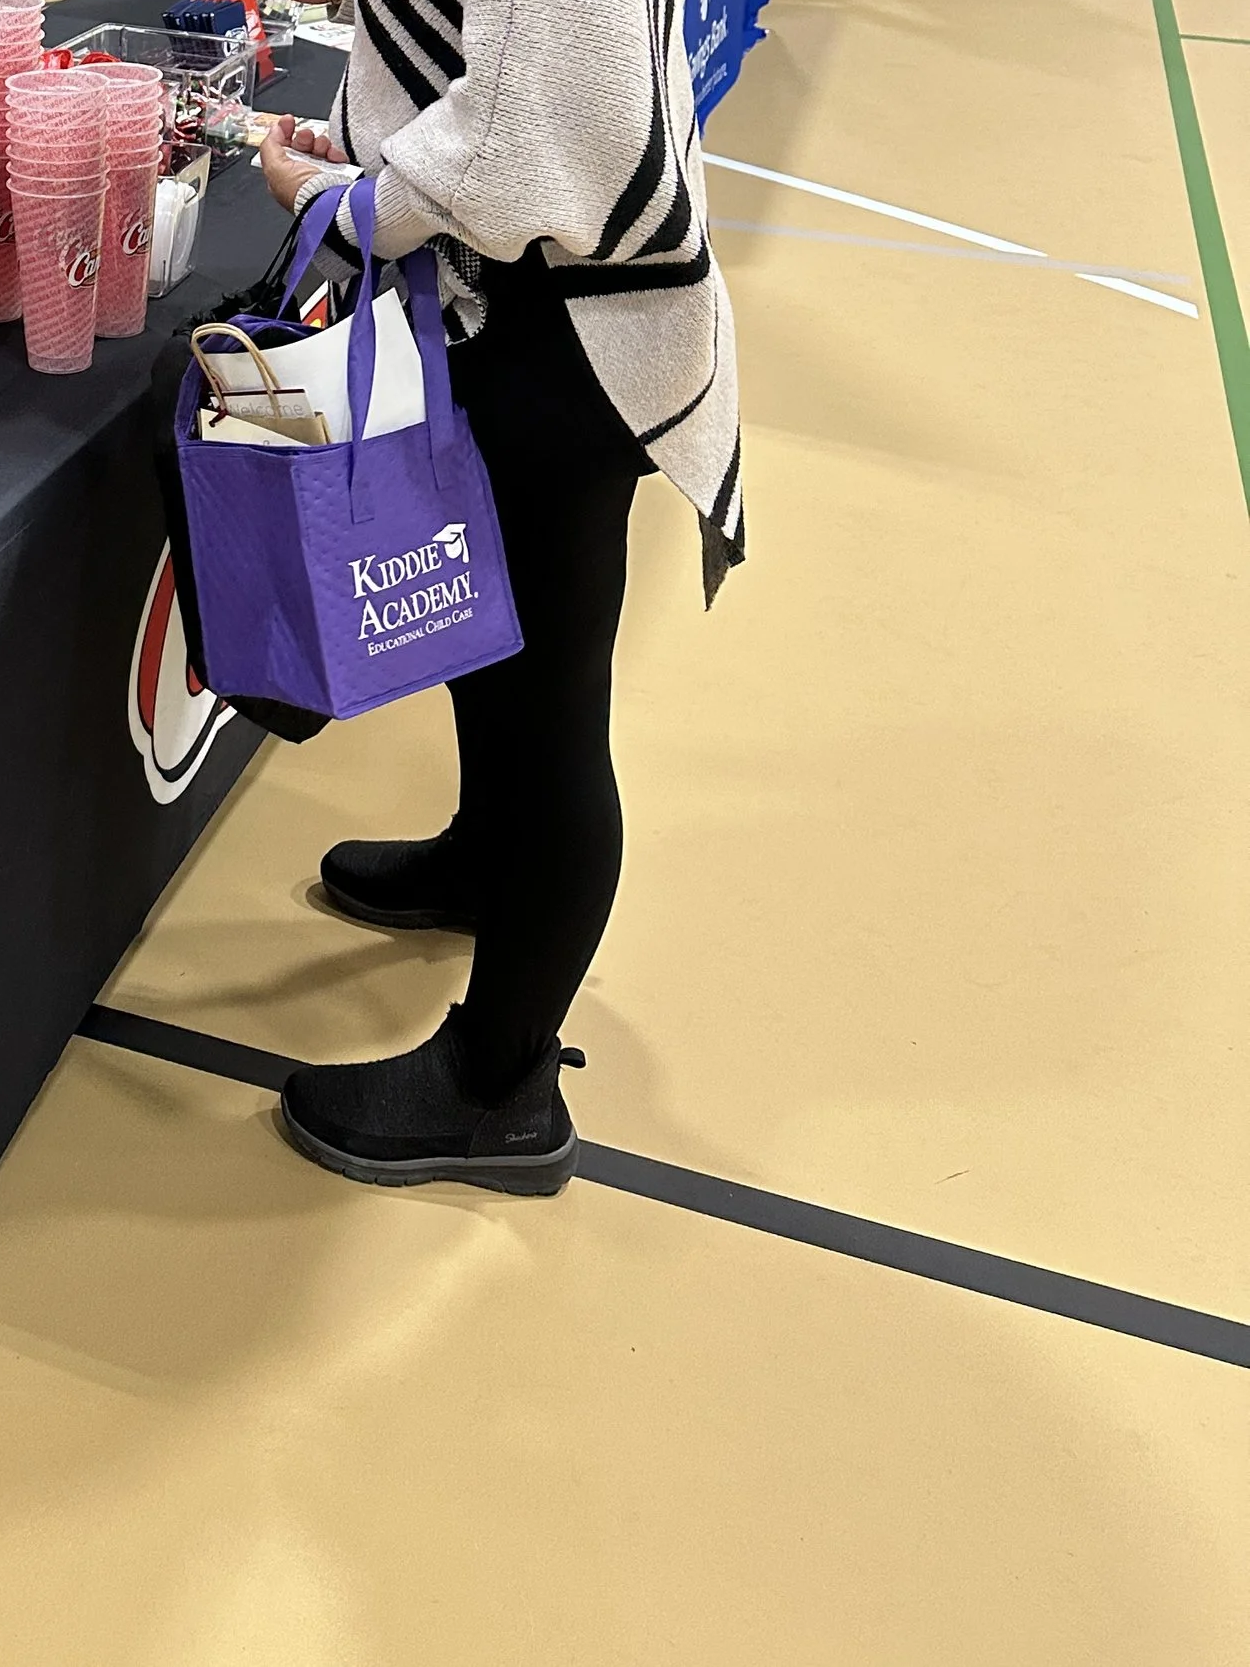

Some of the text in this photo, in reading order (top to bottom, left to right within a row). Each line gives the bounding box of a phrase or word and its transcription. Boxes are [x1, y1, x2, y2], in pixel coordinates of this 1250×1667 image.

[368, 607, 474, 657] EDUCATIONAL CHILD CARE
